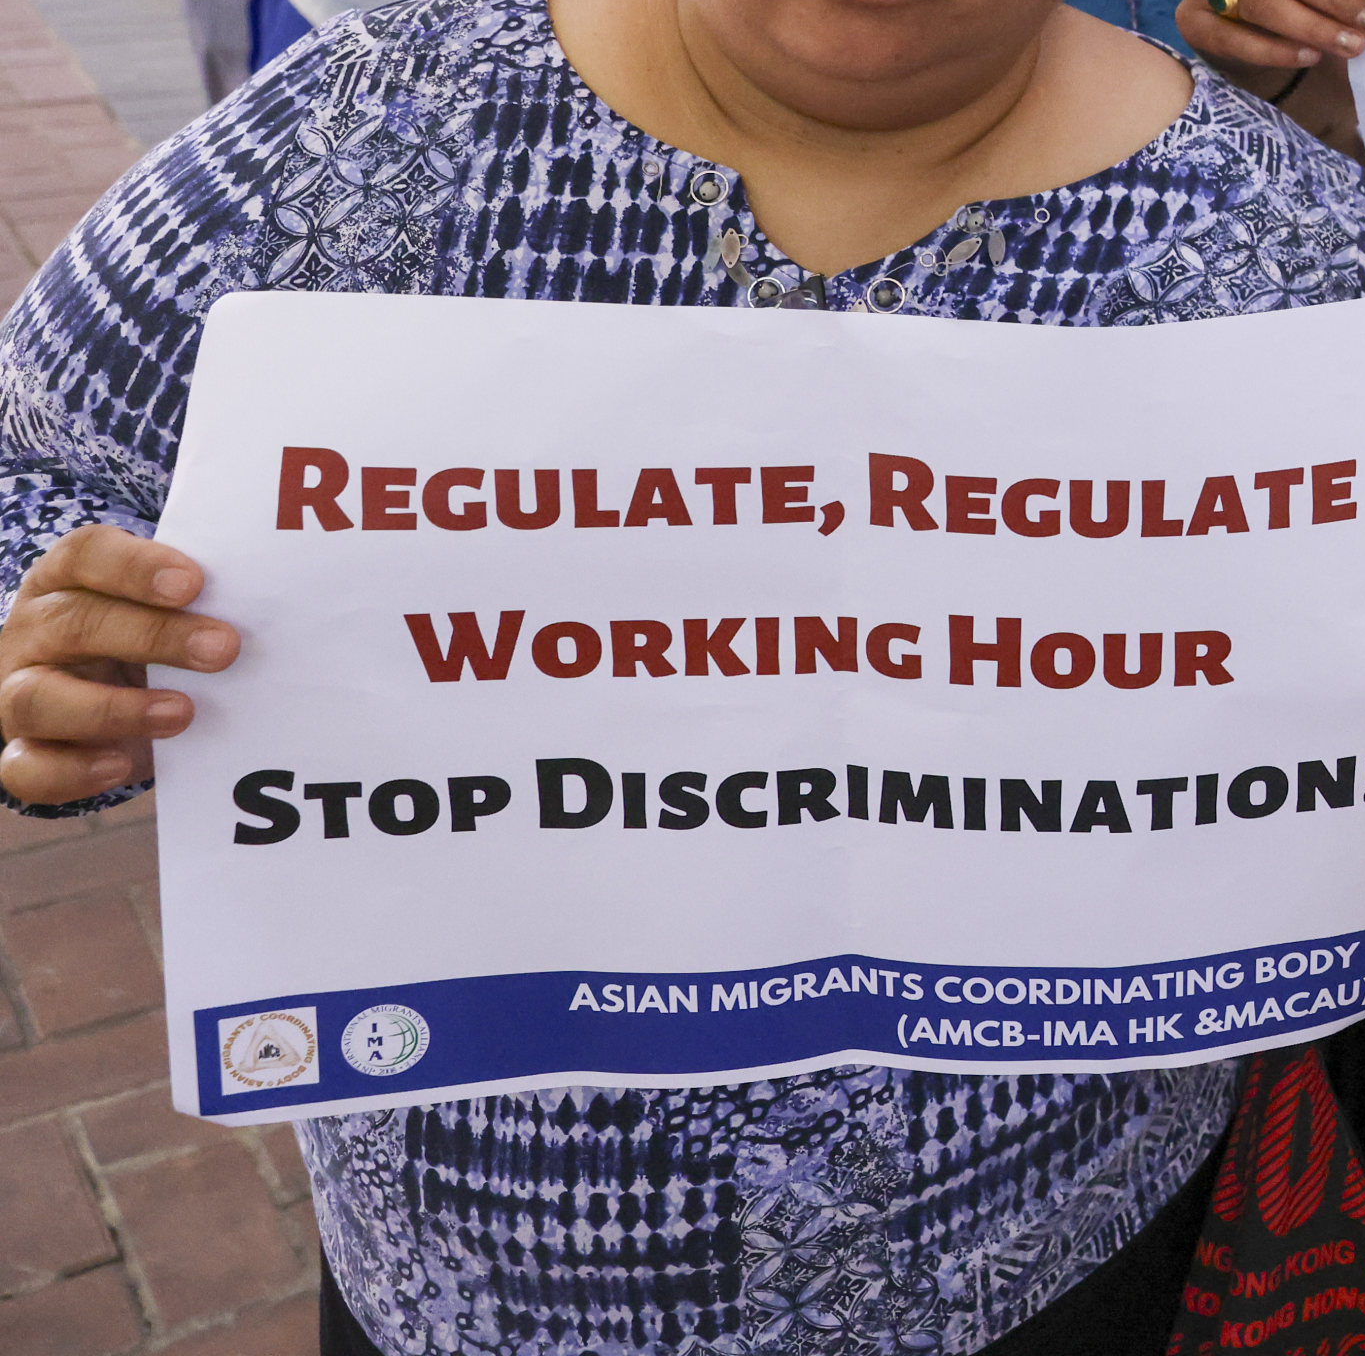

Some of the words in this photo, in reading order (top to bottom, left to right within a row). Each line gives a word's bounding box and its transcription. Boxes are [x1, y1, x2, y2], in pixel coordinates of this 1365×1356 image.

[273, 445, 848, 538] REGULATE,
[866, 451, 1360, 539] REGULATE
[401, 608, 923, 684] WORKING
[947, 613, 1236, 691] HOUR
[231, 767, 513, 846] STOP
[568, 975, 701, 1015] ASIAN
[708, 966, 926, 1013] MIGRANTS
[934, 960, 1247, 1010] COORDINATING
[1253, 942, 1363, 984] BODY
[896, 1013, 1120, 1053] (AMCB-IMA
[1127, 1014, 1184, 1044] HK
[1284, 1239, 1355, 1281] KONG
